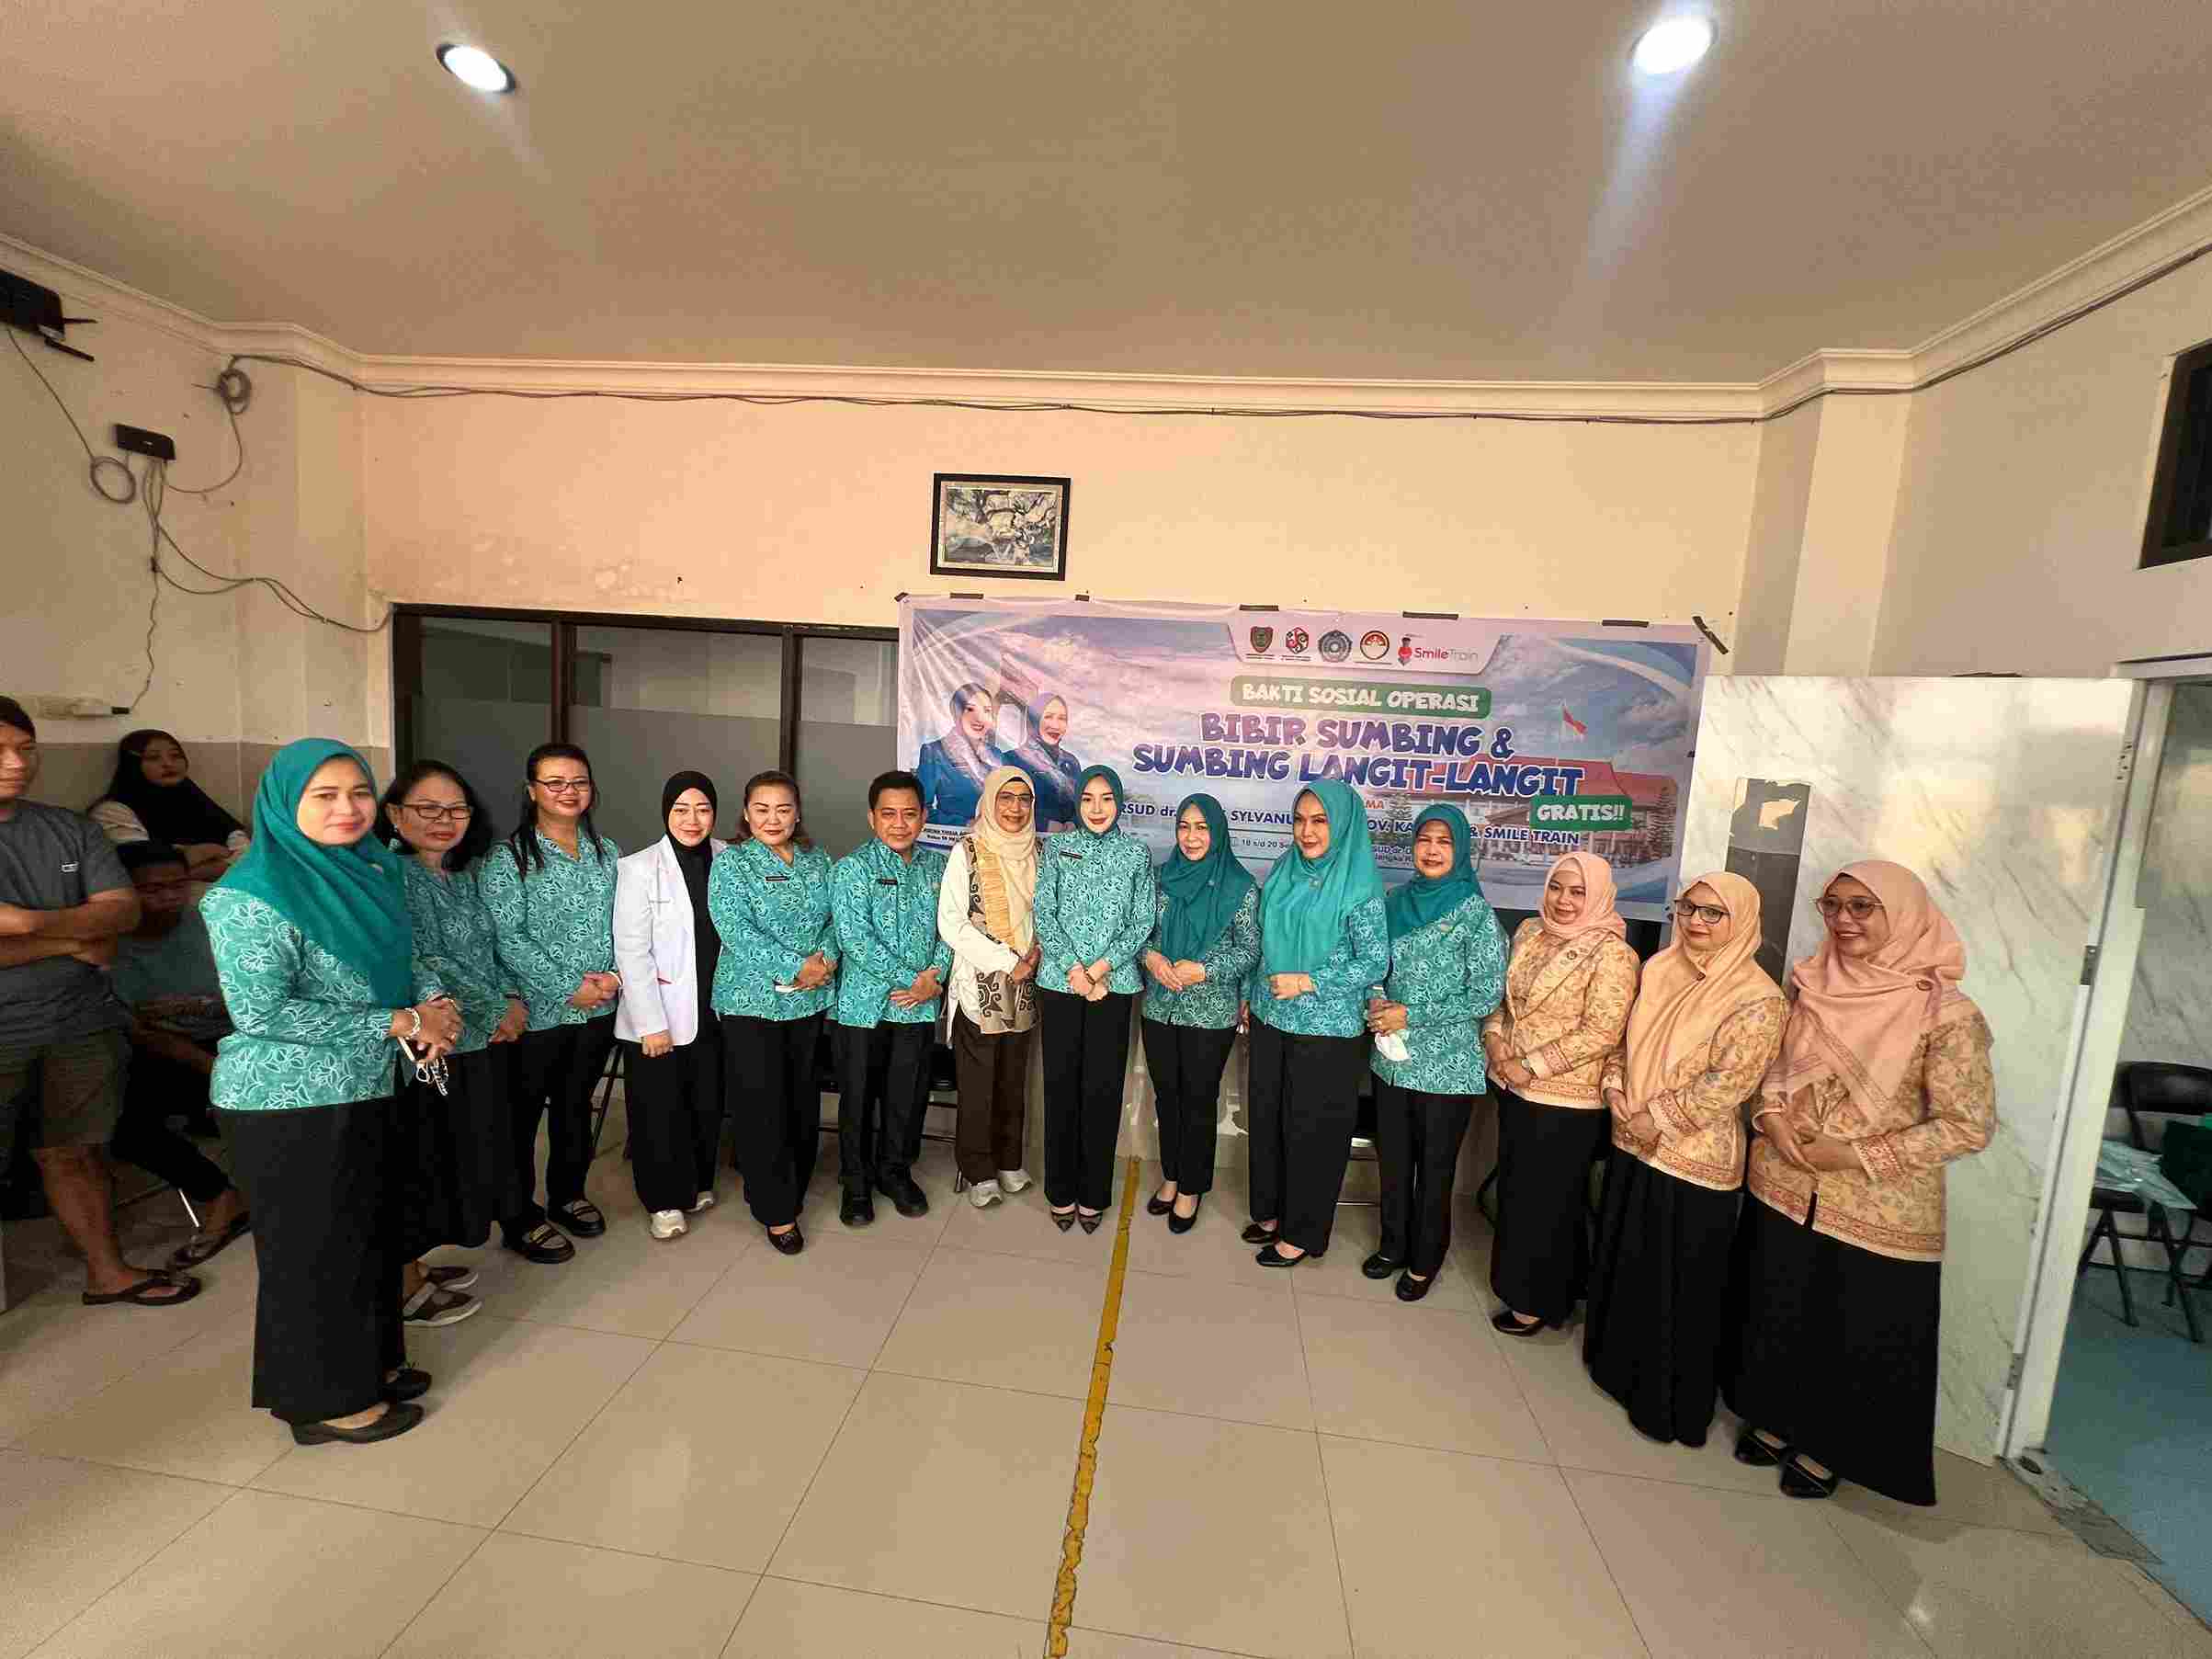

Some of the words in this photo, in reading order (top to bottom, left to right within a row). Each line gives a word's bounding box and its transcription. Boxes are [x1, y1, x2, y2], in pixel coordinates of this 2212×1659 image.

[1242, 683, 1303, 703] BAKTI
[1309, 687, 1381, 707] SOSIAL
[1386, 690, 1479, 712] OPERASI
[1200, 712, 1307, 746] BIBIR
[1316, 717, 1484, 757] SUMBING
[1491, 726, 1515, 761] &
[1132, 743, 1291, 780] SUMBING
[1298, 752, 1585, 797] LANGIT-LANGIT
[1231, 810, 1293, 824] SYLVANU
[1367, 819, 1389, 832] OV.
[1484, 826, 1528, 841] SMILE
[1533, 829, 1580, 845] TRAIN
[1537, 803, 1625, 821] GRATIS!!
